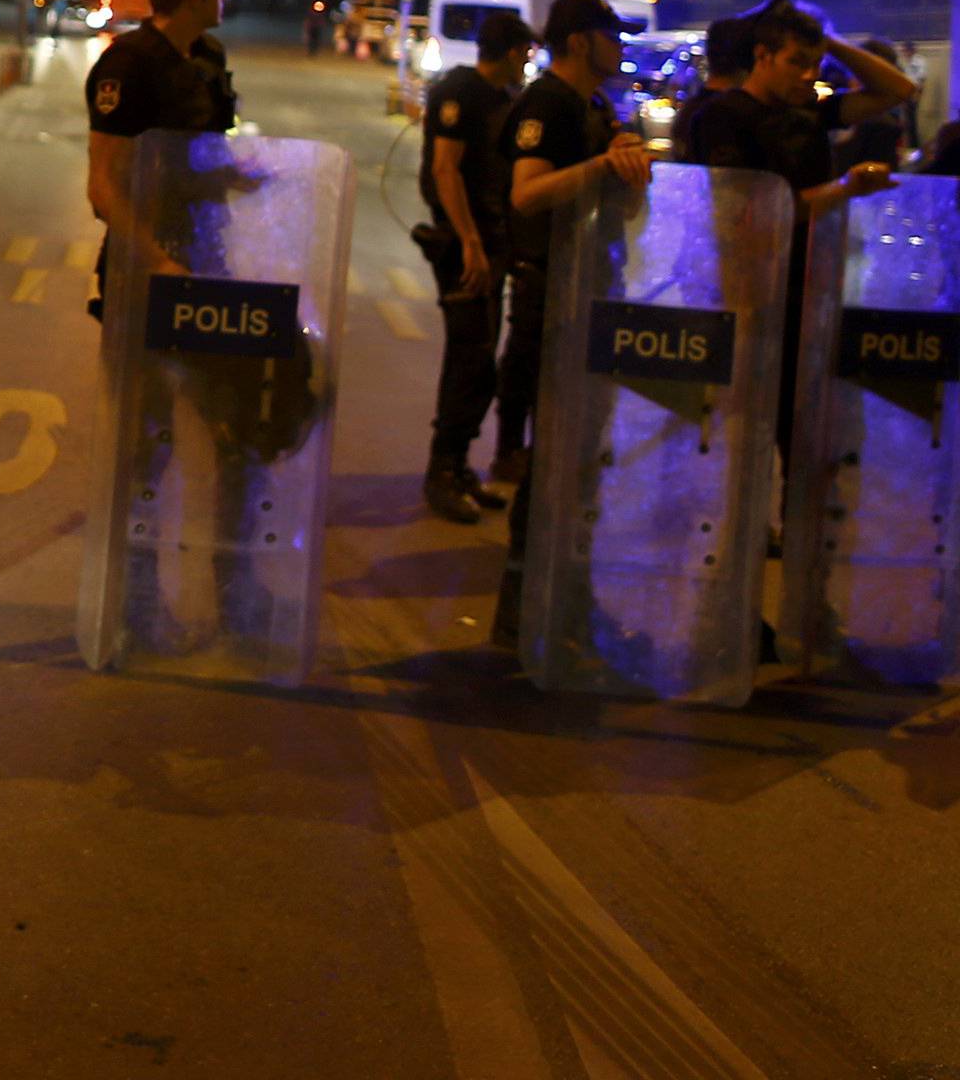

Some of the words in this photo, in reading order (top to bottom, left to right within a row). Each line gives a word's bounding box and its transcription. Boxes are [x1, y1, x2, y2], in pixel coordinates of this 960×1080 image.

[172, 301, 269, 336] POLİS
[613, 327, 708, 362] POLİS
[861, 328, 941, 363] POLİS
